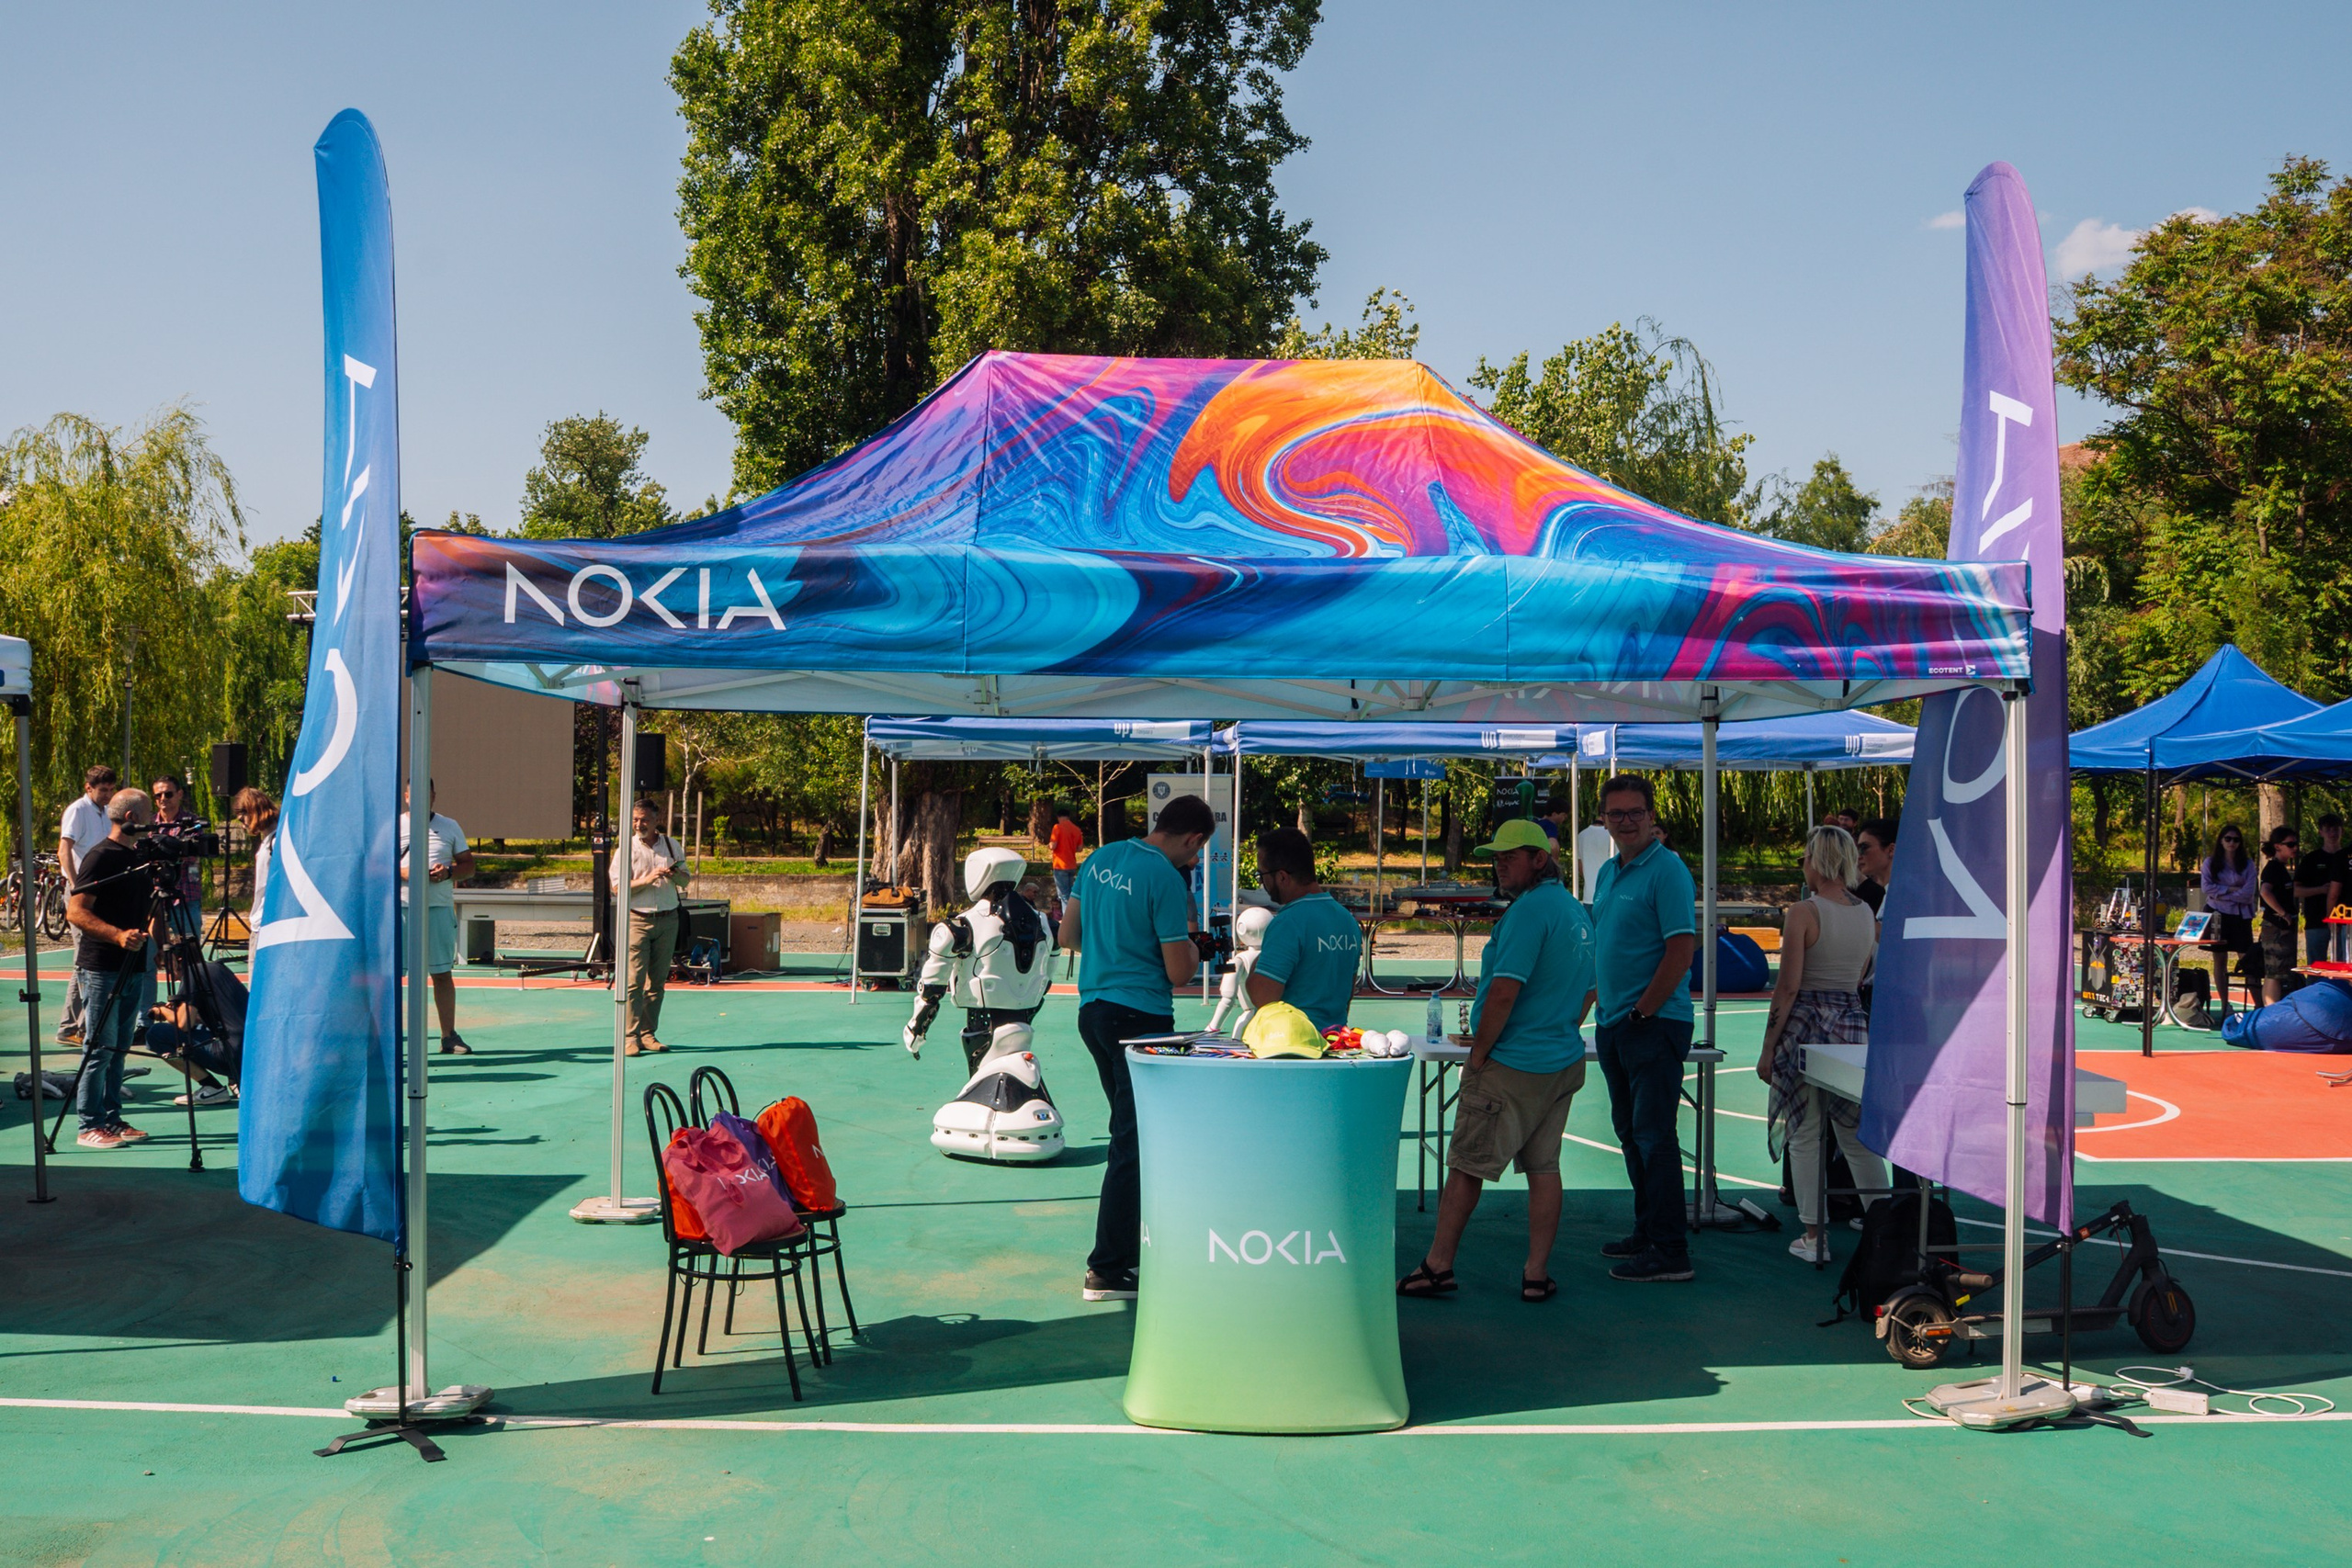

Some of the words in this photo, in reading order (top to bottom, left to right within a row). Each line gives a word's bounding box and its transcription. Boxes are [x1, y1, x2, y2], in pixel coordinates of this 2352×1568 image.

[504, 560, 786, 630] NOKIA
[1497, 787, 1520, 795] NOKIA
[1087, 863, 1132, 896] NOKIA
[1317, 934, 1358, 953] NOKIA
[1208, 1227, 1347, 1265] NOKIA
